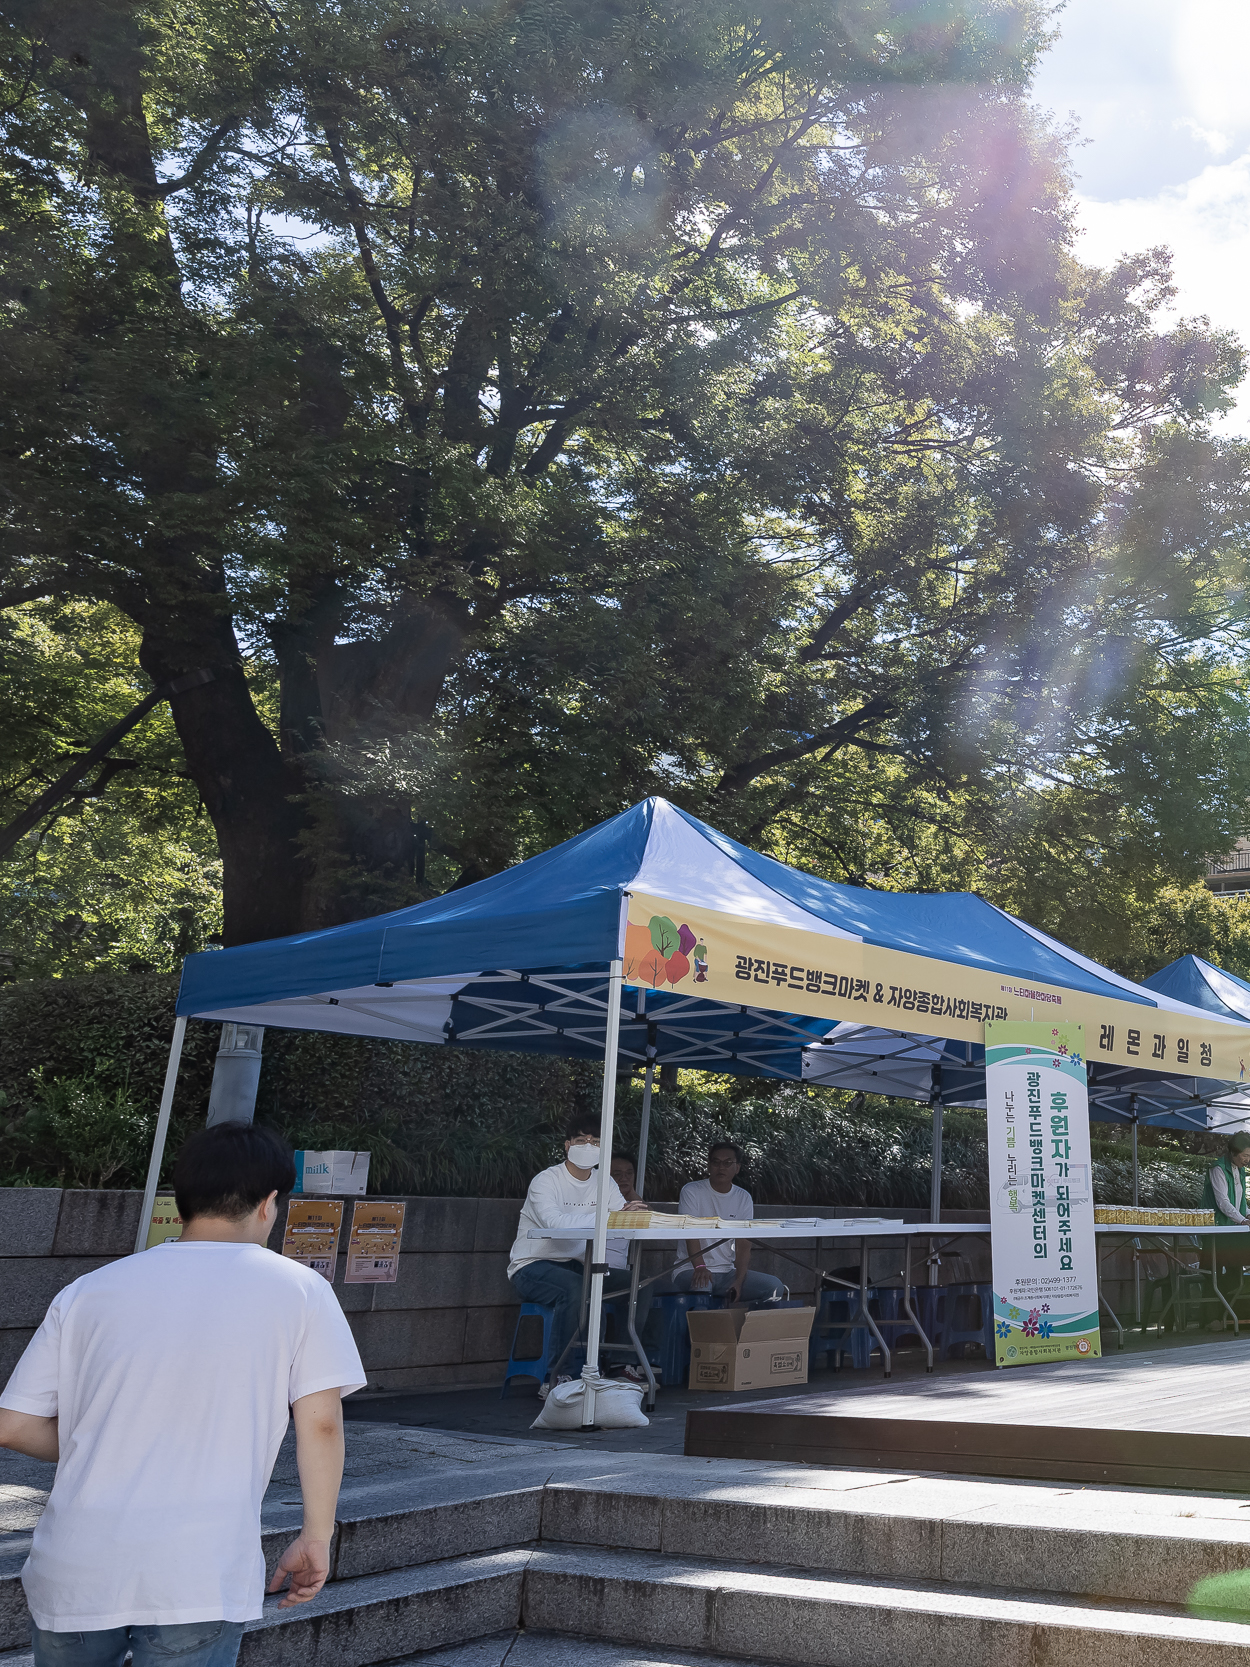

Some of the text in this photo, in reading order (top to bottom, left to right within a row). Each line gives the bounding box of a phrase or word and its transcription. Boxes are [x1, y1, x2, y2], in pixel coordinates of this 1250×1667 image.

[734, 954, 870, 1003] 광진푸드뱅크마켓
[872, 982, 884, 1003] &
[305, 1163, 329, 1174] miilk
[1005, 1090, 1018, 1212] 나누는 기쁨 누리는 행복
[1026, 1071, 1048, 1259] 광진푸드뱅크마켓센터의
[1050, 1091, 1074, 1271] 후원자가 되어주세요
